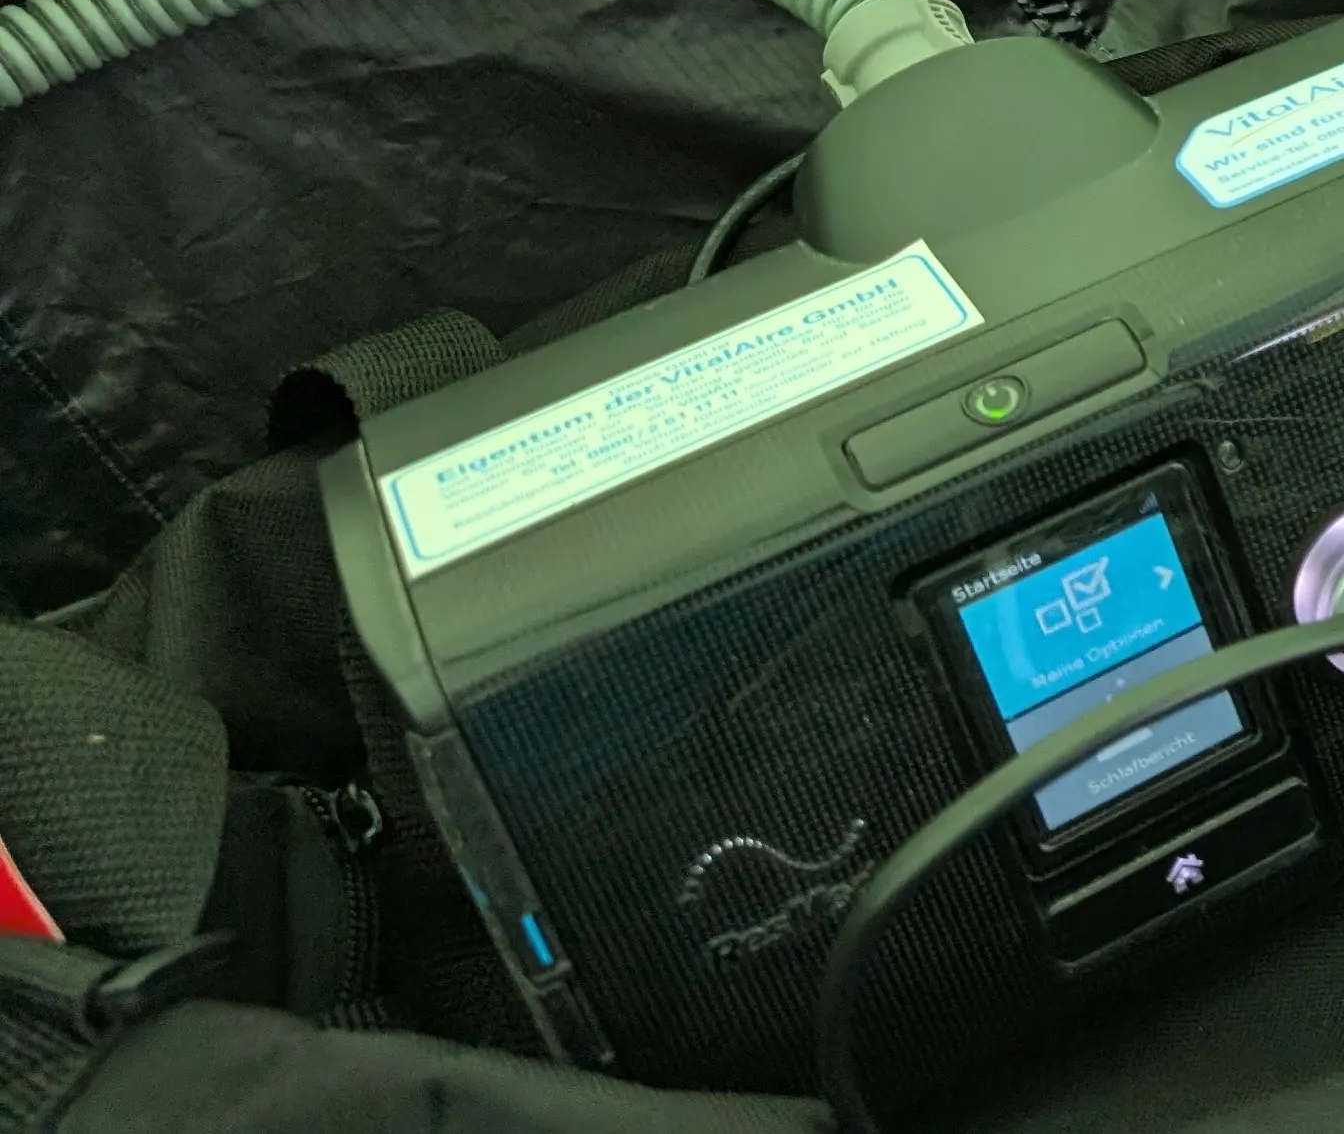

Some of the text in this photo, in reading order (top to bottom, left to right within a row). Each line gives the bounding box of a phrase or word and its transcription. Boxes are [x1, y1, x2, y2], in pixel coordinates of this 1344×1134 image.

[1204, 148, 1249, 172] Wir
[1256, 125, 1306, 151] sind
[1310, 109, 1344, 130] für
[434, 405, 596, 488] Eigentum
[601, 380, 658, 413] der
[658, 319, 796, 389] VitalAire
[799, 276, 898, 327] GmbH
[951, 552, 1043, 604] Startseite
[1031, 616, 1166, 690] Meine Optionen
[1086, 728, 1198, 796] Schlafbericht
